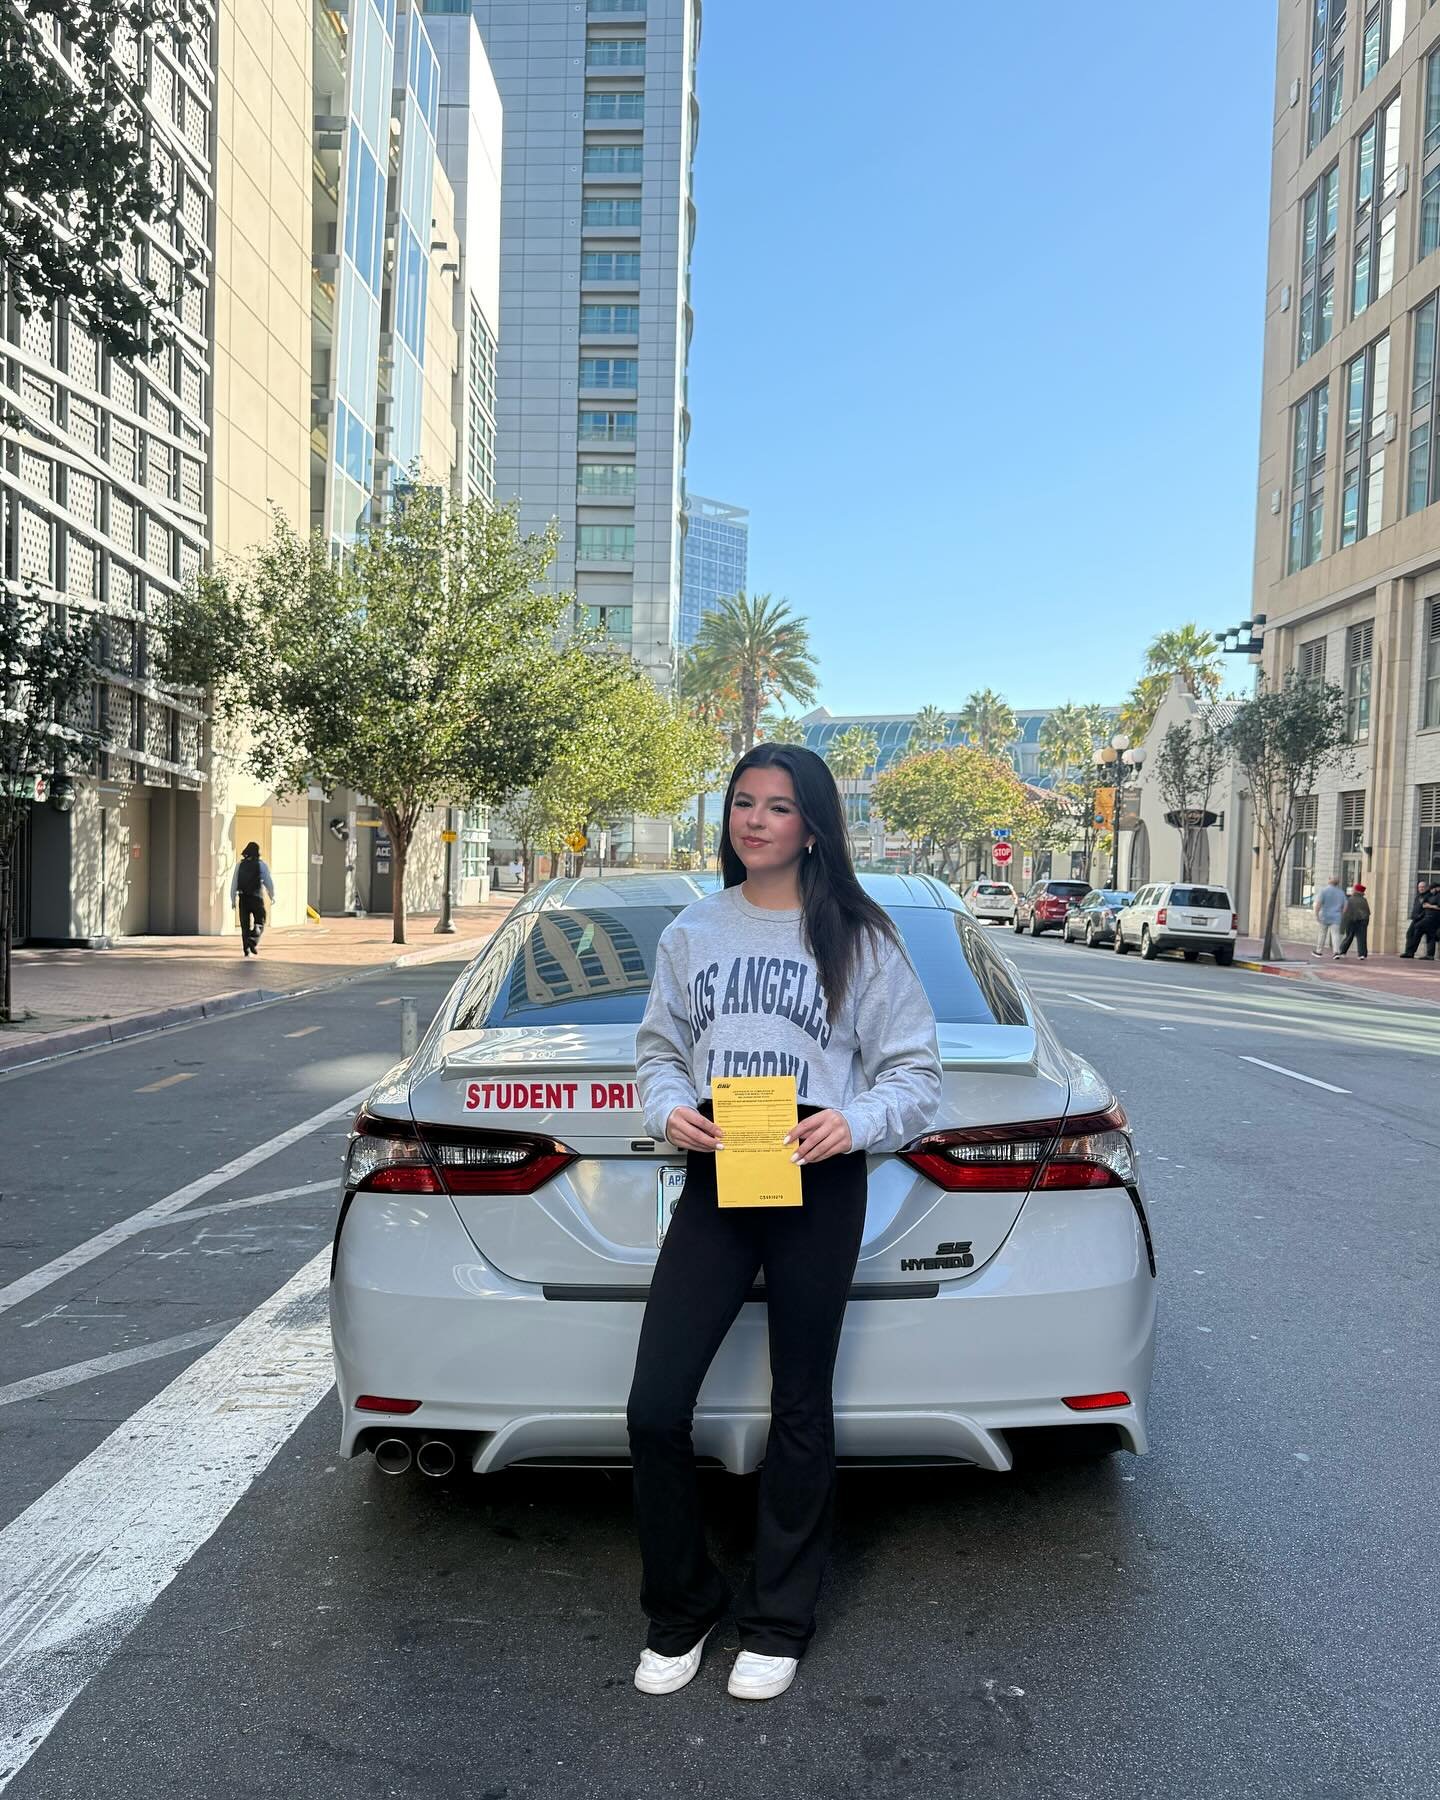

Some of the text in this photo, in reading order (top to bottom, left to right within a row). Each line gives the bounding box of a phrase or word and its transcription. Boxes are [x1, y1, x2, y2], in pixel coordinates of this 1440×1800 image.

[994, 848, 1011, 857] STOP
[687, 962, 719, 1044] LOS
[466, 1083, 578, 1110] STUDENT
[936, 1241, 973, 1255] SE
[901, 1255, 963, 1271] HYBRID
